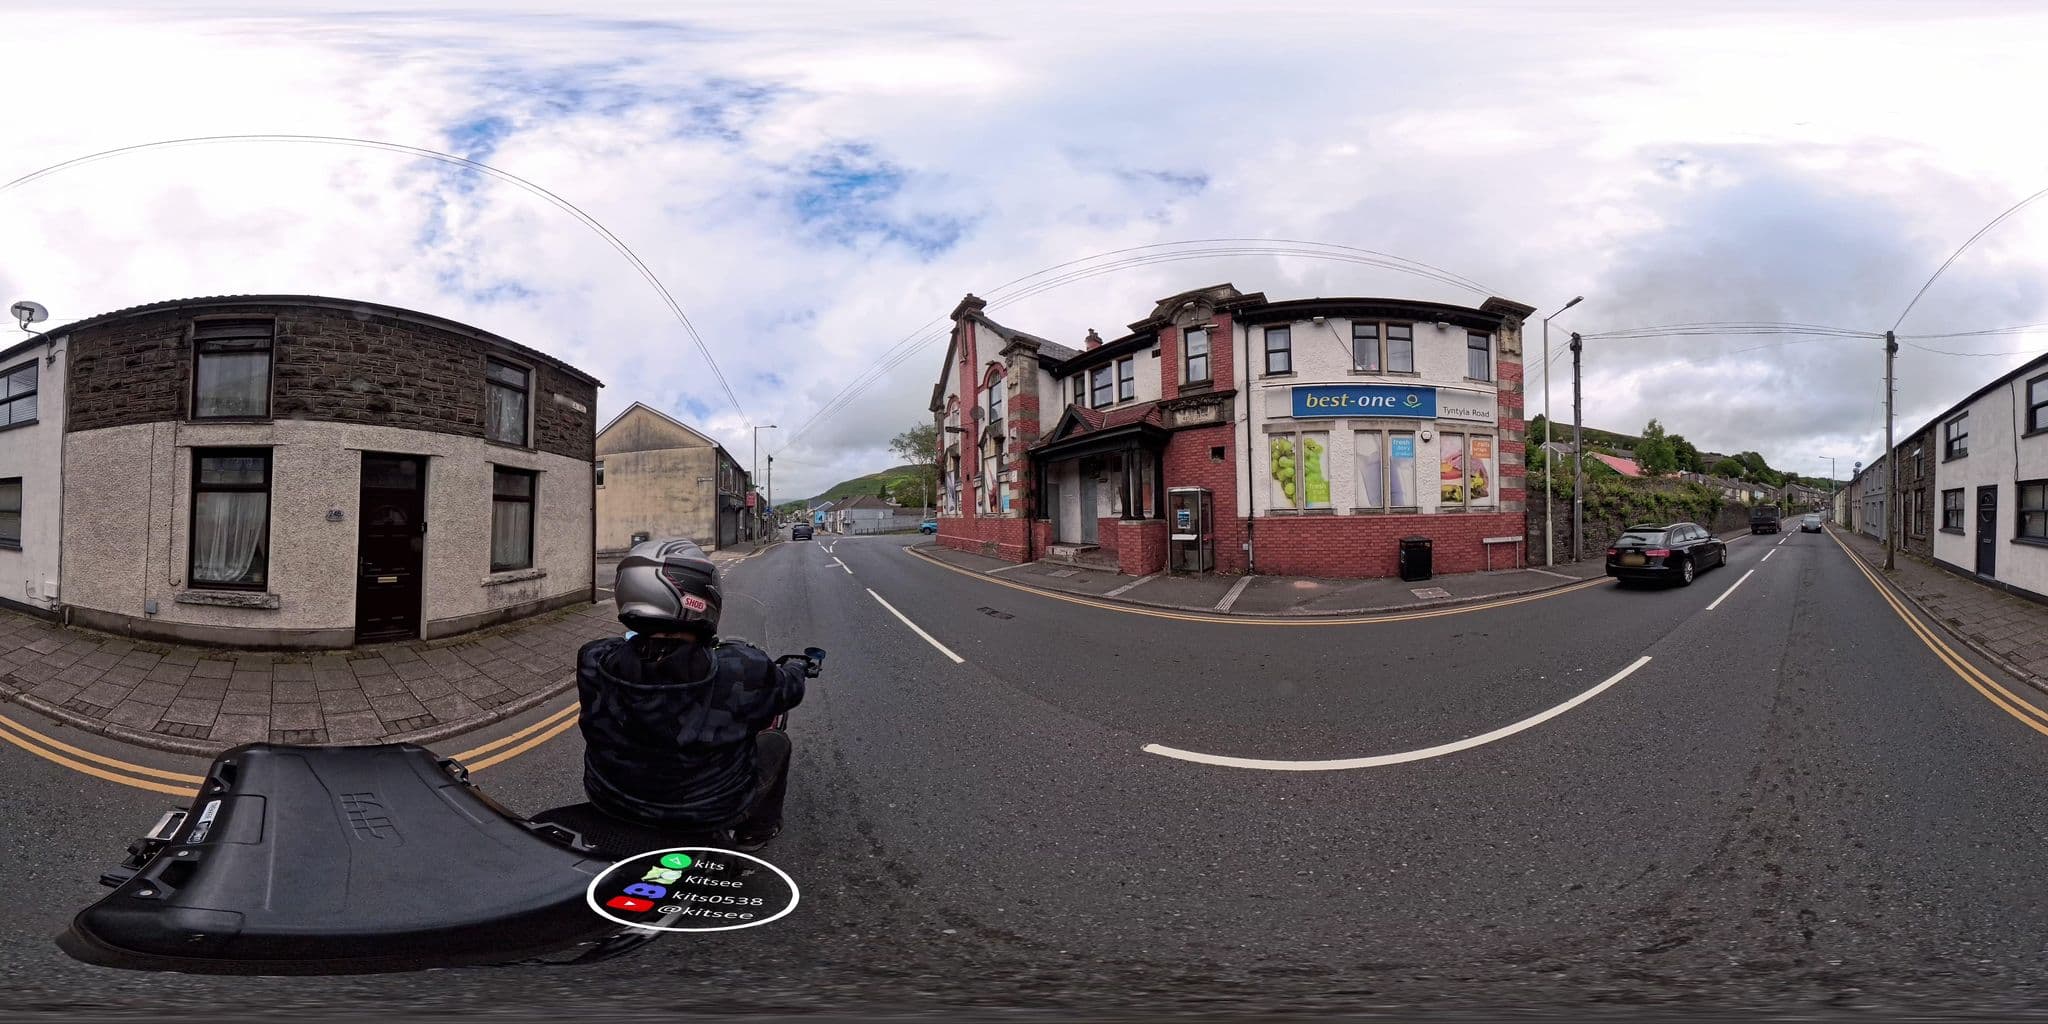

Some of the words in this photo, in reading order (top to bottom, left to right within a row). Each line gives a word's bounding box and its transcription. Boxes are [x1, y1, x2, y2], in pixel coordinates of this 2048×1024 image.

[1306, 393, 1396, 407] best-one
[1443, 406, 1470, 416] Tyntyla
[1472, 409, 1490, 417] Road
